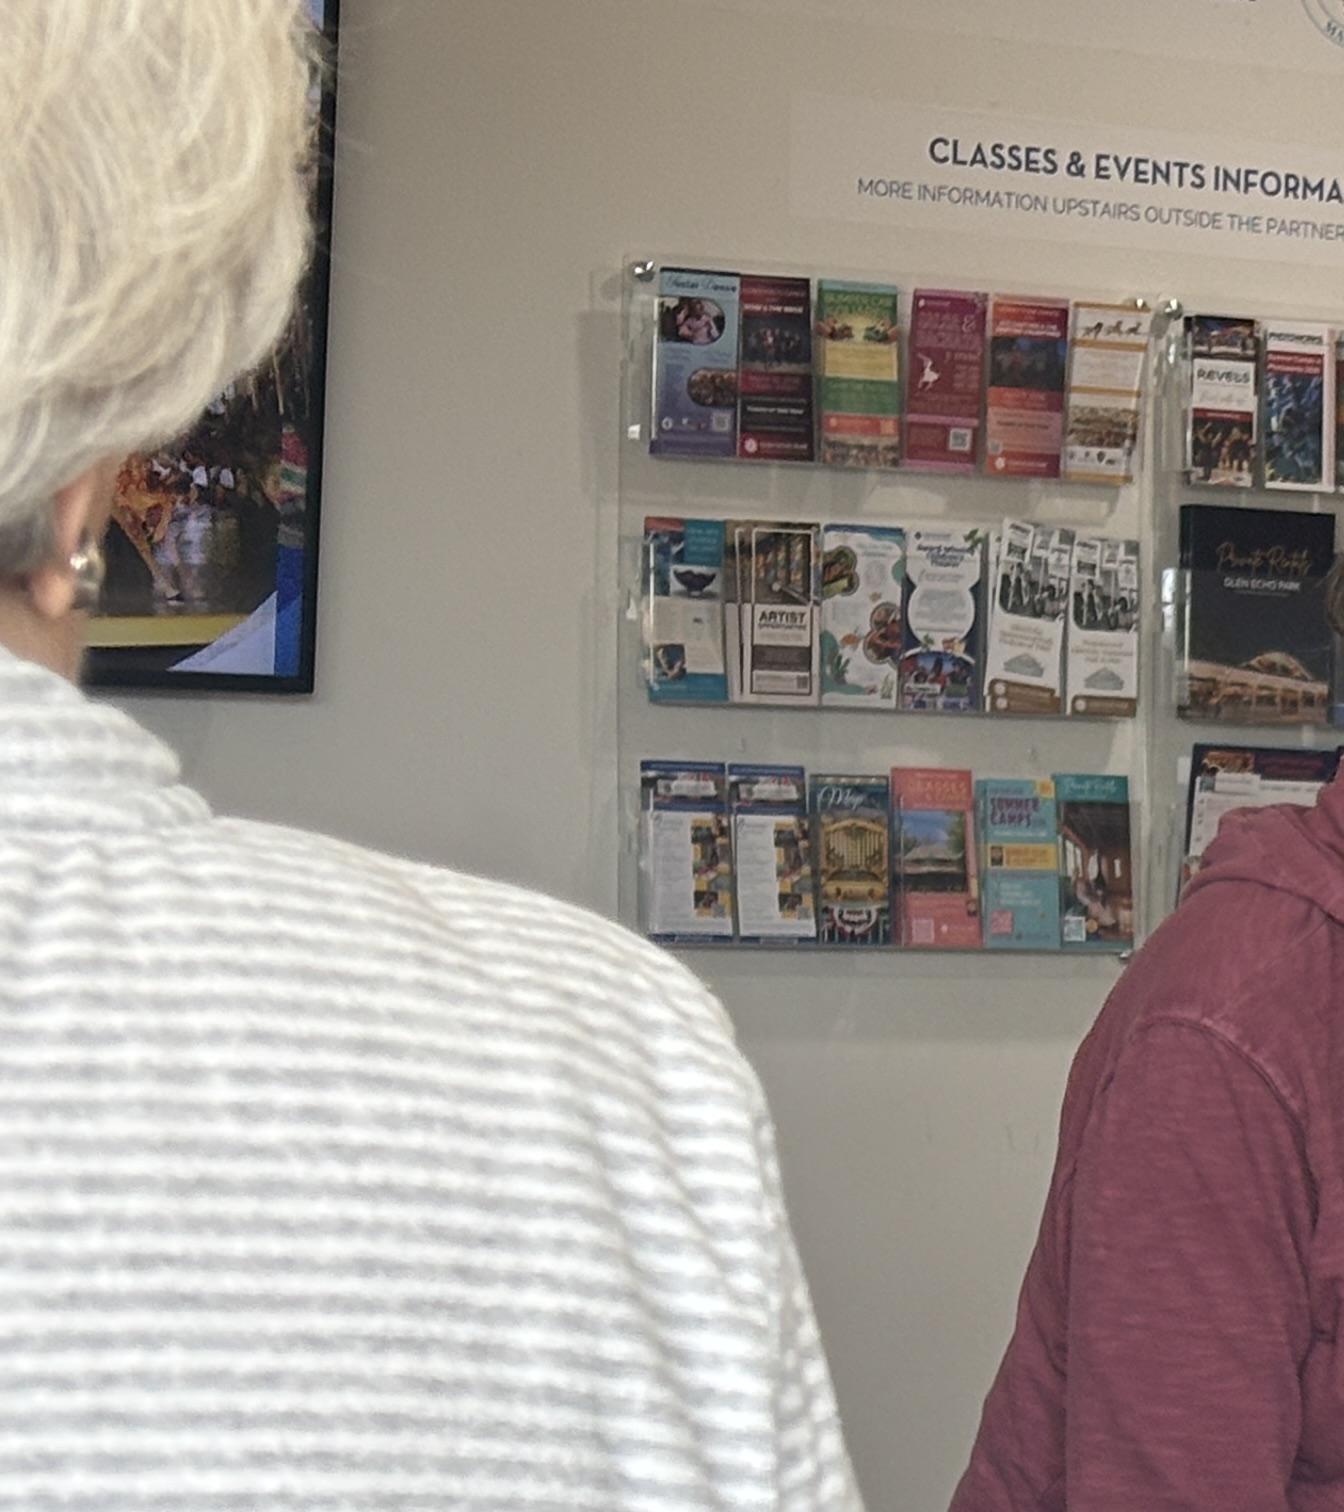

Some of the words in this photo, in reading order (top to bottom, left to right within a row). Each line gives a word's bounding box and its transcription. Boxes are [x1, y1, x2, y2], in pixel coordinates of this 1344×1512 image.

[929, 137, 1058, 175] CLASSES
[1066, 151, 1086, 177] &
[1095, 154, 1205, 190] EVENTS
[857, 178, 913, 200] MORE
[918, 184, 1049, 213] INFORMATION
[1052, 197, 1140, 222] UPSTAIRS
[1144, 205, 1222, 229] OUTSIDE
[1227, 213, 1262, 234] THE
[1197, 369, 1250, 384] REVELS
[759, 610, 807, 624] ARTIST
